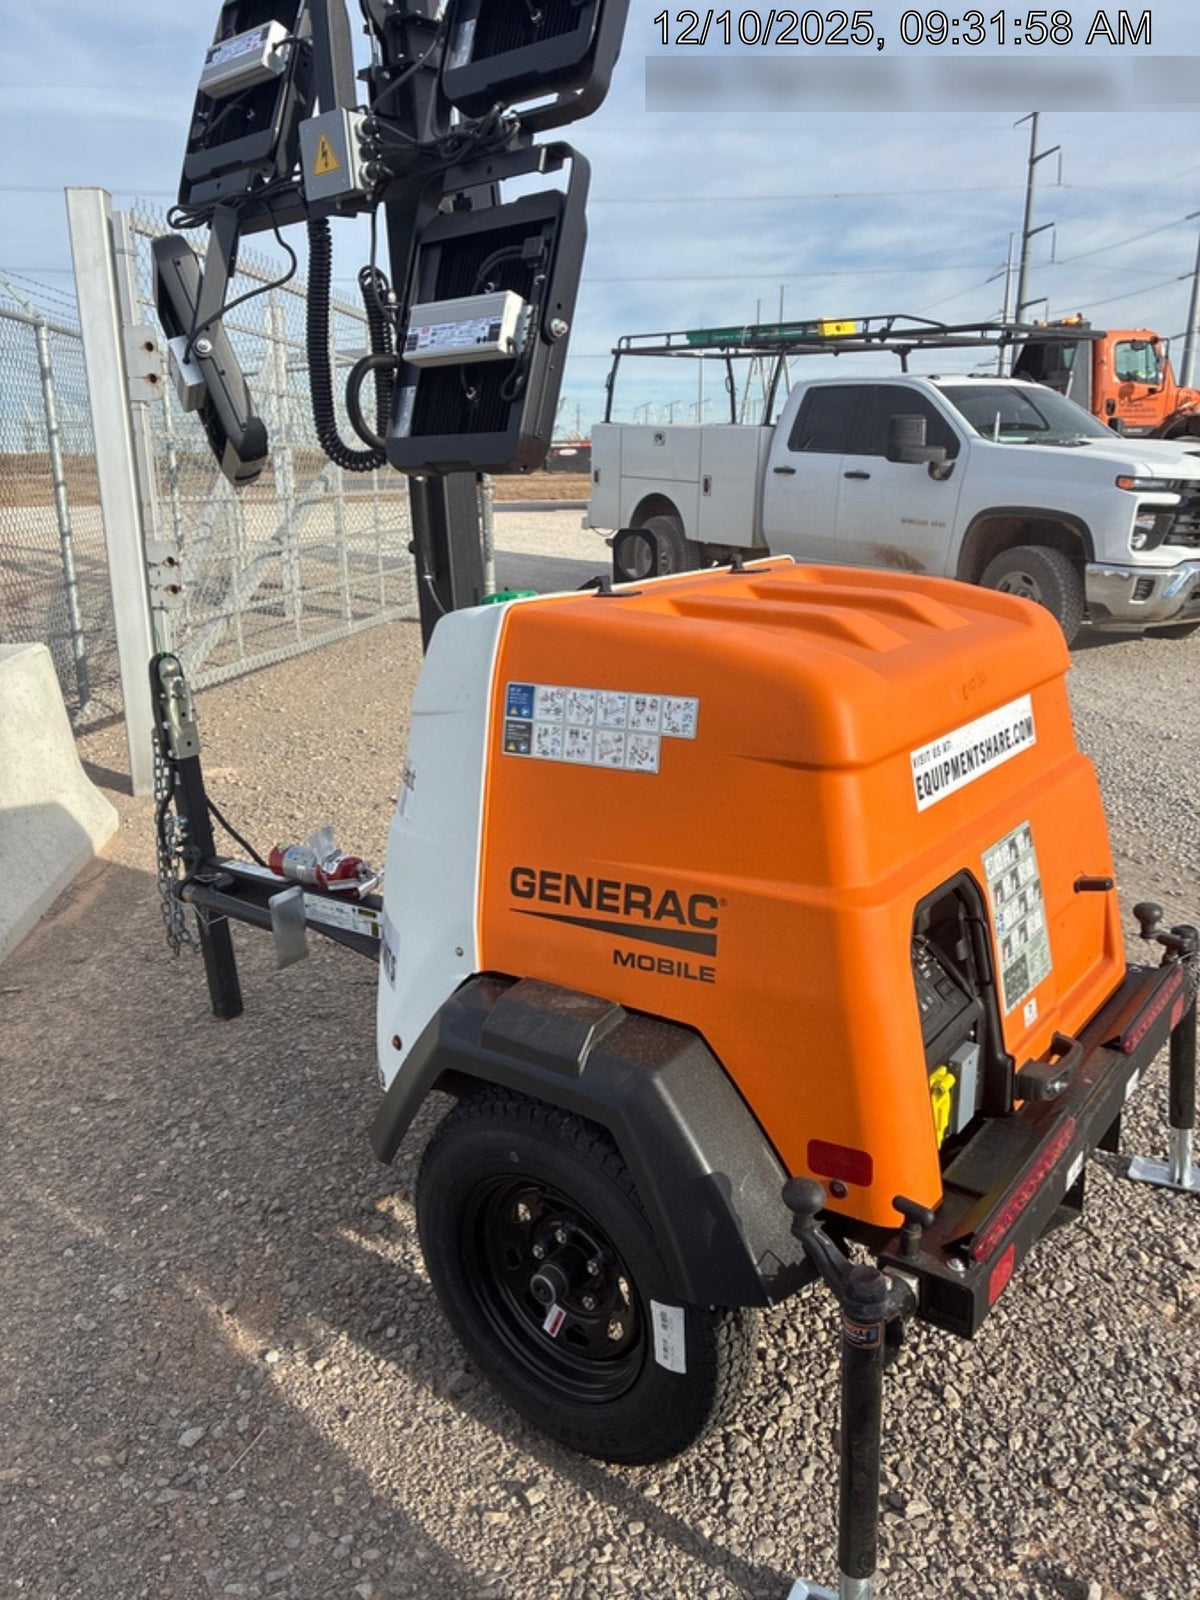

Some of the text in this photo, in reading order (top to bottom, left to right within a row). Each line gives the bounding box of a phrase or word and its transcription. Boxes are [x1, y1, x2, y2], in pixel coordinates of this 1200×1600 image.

[915, 717, 1033, 800] EQUIPMENTSHARE.COM
[510, 866, 719, 930] GENERAC
[612, 949, 717, 984] MOBILE
